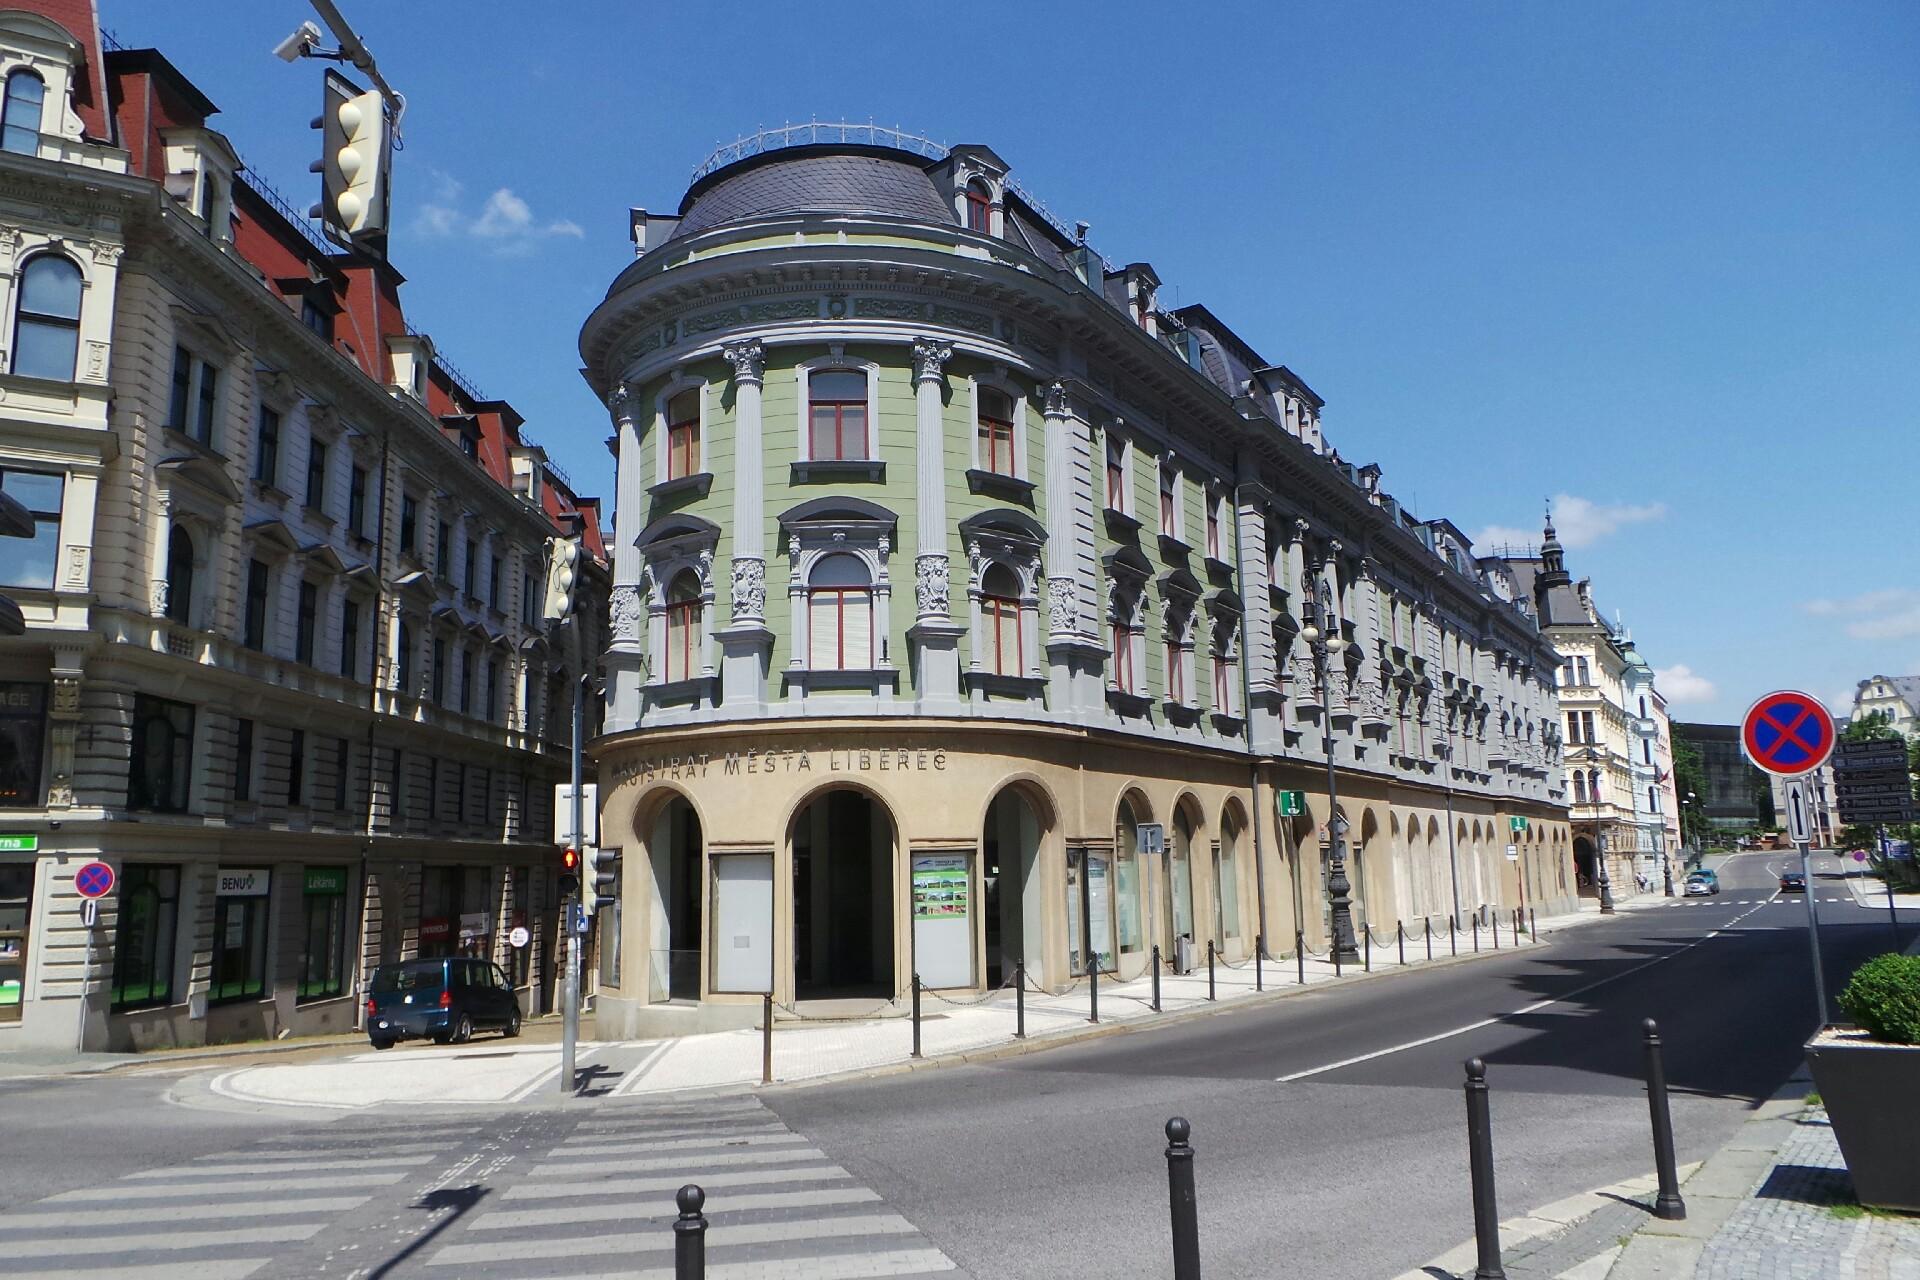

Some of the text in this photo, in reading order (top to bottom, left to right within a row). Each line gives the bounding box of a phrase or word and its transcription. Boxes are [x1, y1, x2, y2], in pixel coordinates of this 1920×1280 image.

[725, 748, 811, 770] MĚSTA
[830, 748, 947, 769] LIBEREC
[222, 877, 246, 890] BENU
